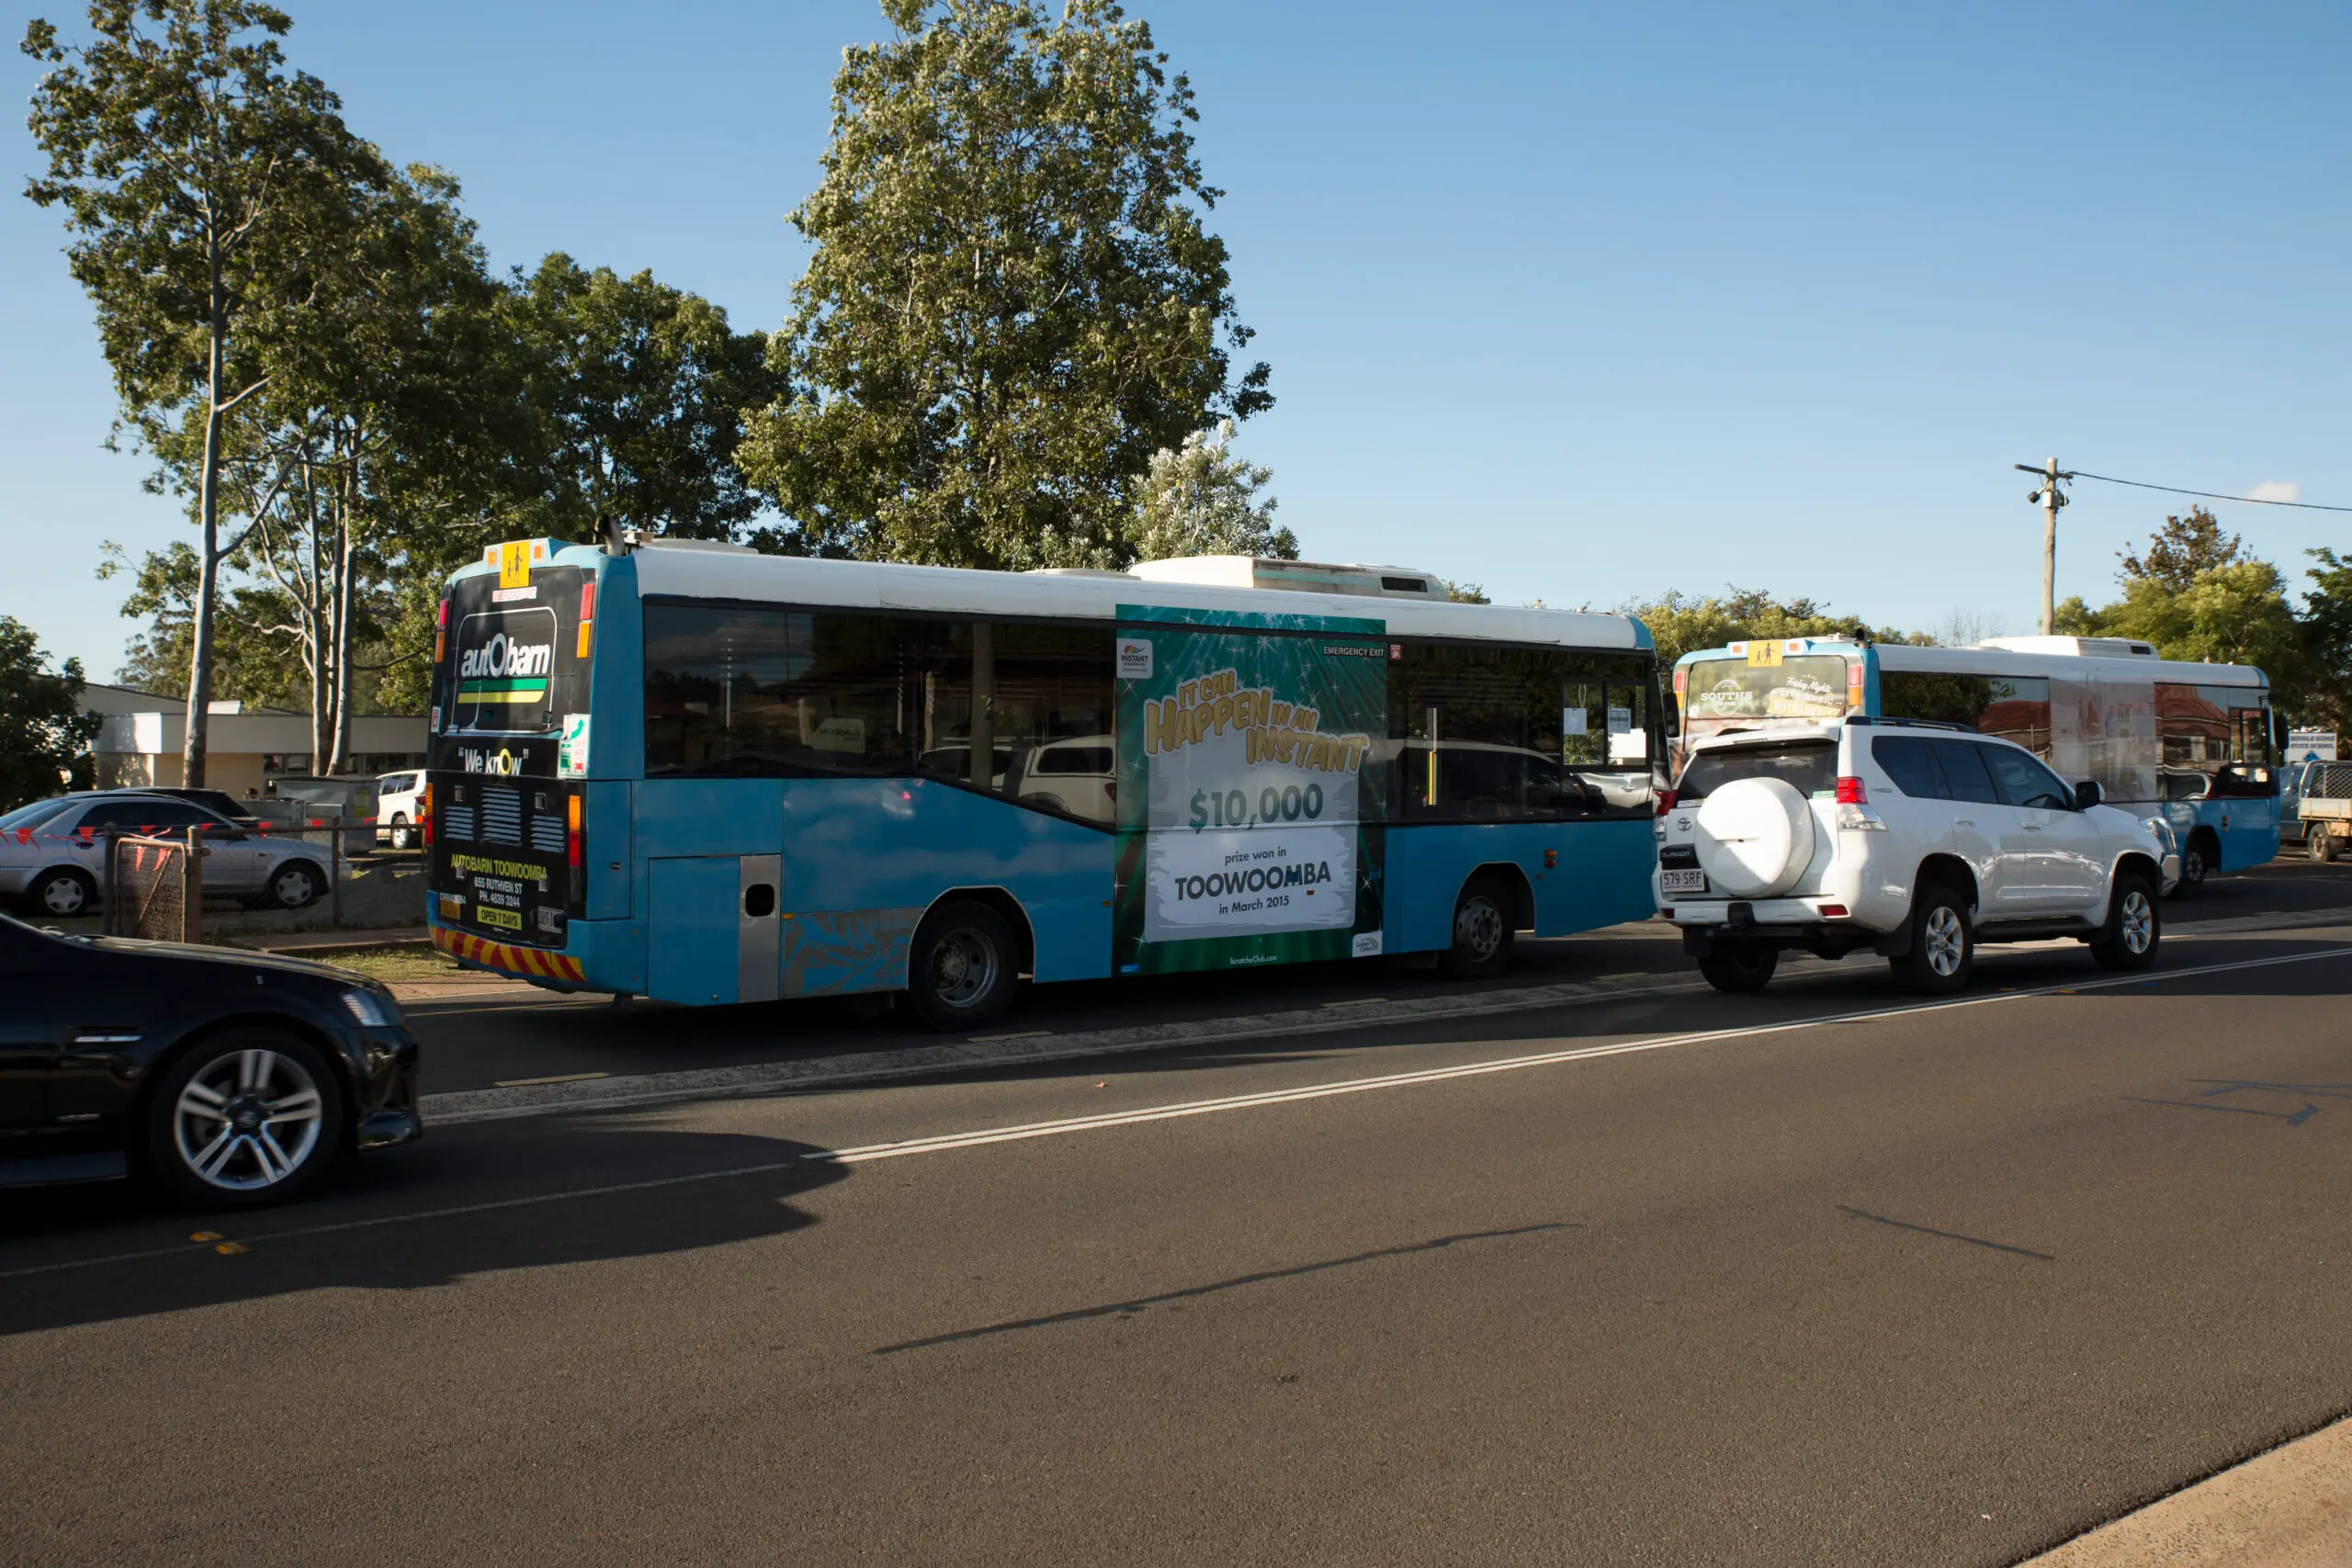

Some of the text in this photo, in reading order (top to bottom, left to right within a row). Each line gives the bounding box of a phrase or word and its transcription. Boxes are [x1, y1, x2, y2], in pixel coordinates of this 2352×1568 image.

[1121, 654, 1148, 662] INSTANT
[1324, 646, 1385, 657] EMERGENCY EXIT
[1179, 671, 1235, 708] IT CAN
[1701, 691, 1753, 702] SOUTHS
[1146, 690, 1317, 755] HAPPEN IN AN
[1246, 727, 1368, 773] INSTANT
[1189, 784, 1324, 834] $10,000
[1225, 846, 1286, 866] prize won in
[451, 854, 547, 880] AUTOBARN TOOWOOMBA
[486, 878, 514, 893] RUTHVEN
[514, 883, 523, 894] ST
[1175, 861, 1331, 900] TOOWOOMBA
[479, 891, 489, 901] PH.
[491, 894, 505, 905] 4639
[505, 895, 521, 908] 3244
[1219, 896, 1290, 915] in March 2015
[481, 909, 518, 927] OPEN 7 DAYS
